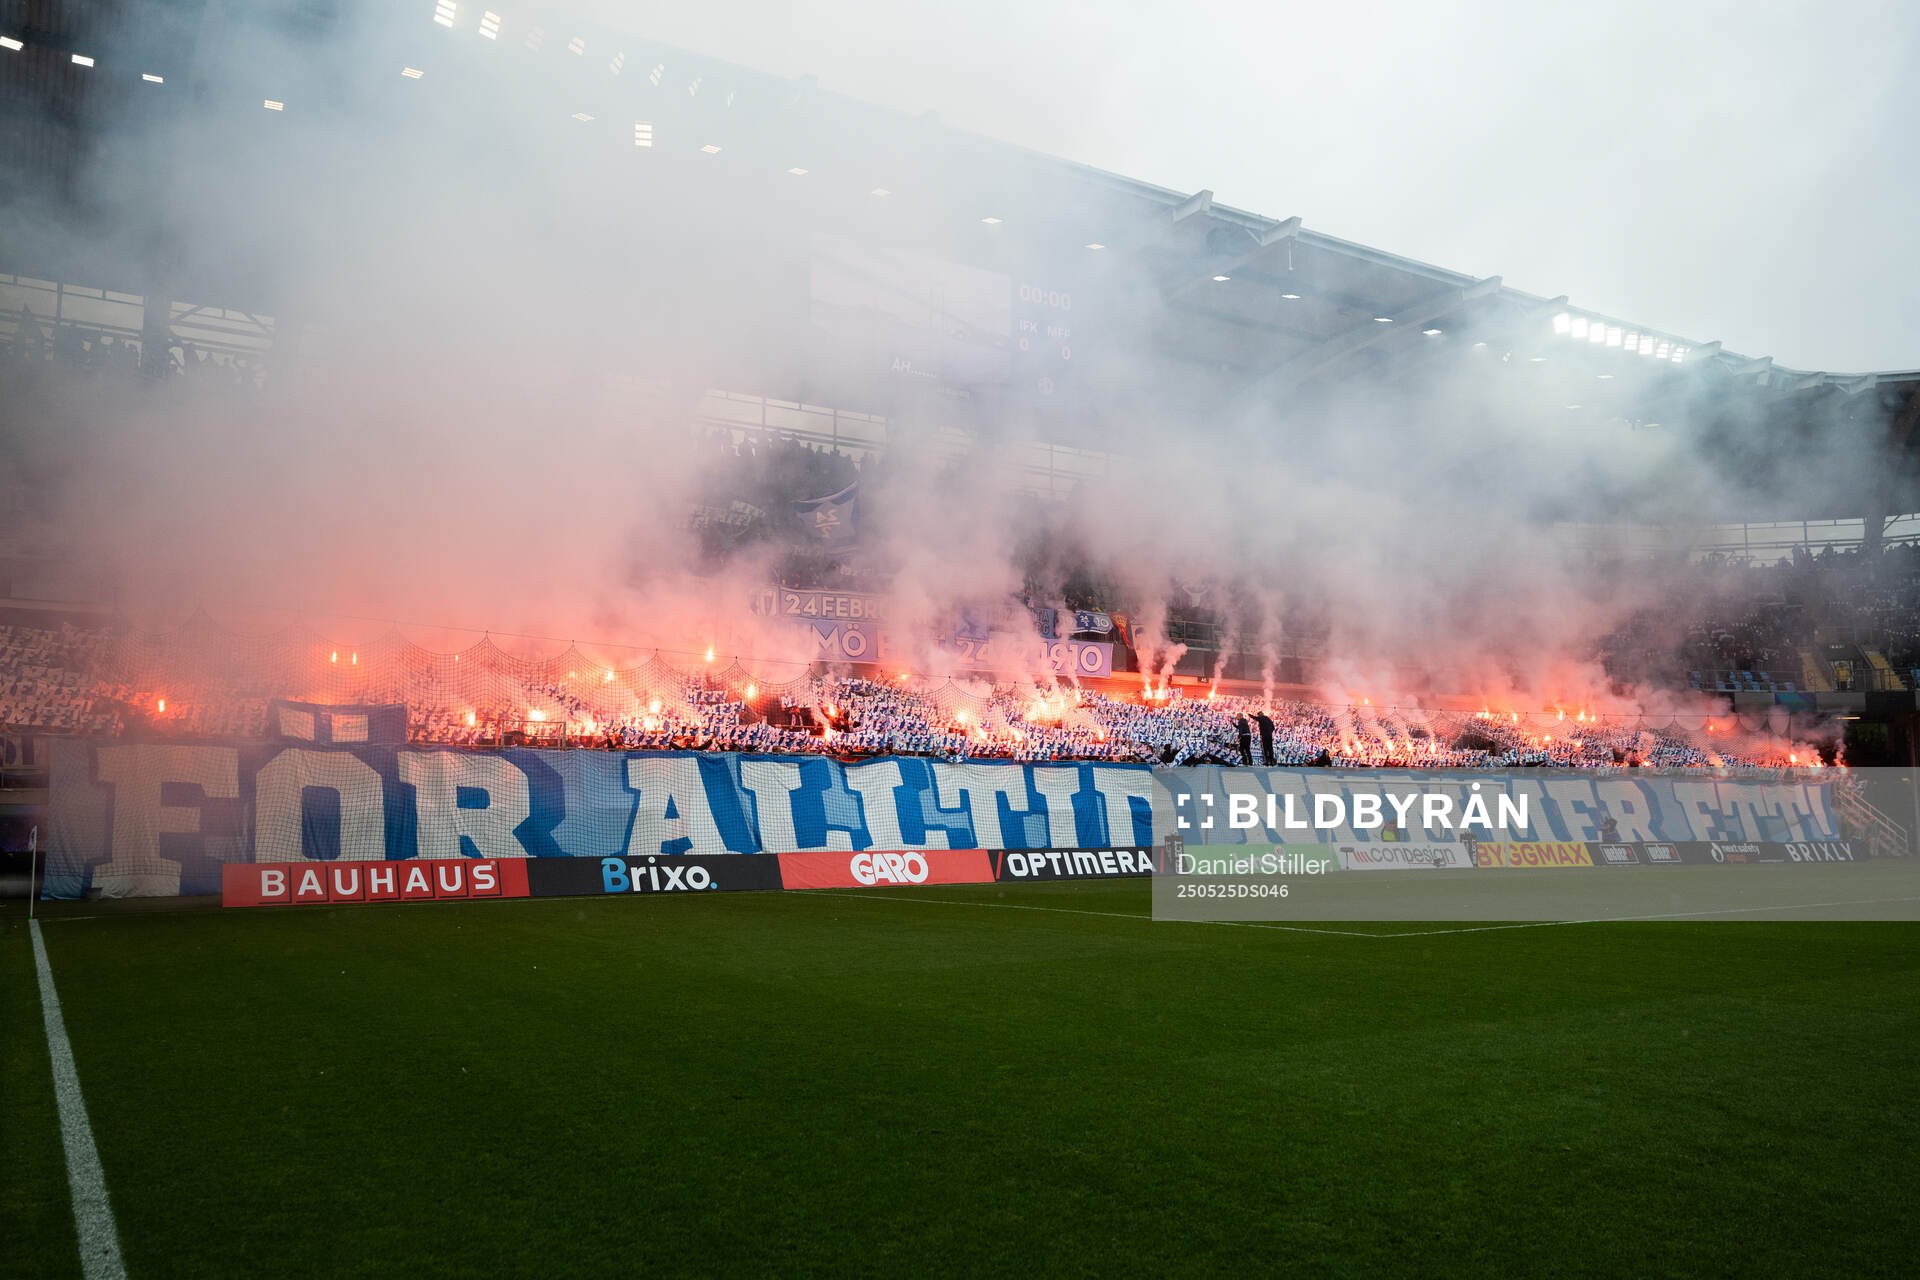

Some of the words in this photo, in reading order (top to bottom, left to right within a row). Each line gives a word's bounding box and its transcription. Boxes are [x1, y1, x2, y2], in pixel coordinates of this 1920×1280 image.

[1020, 286, 1072, 311] 00:00
[92, 706, 537, 898] FÖR
[626, 755, 1181, 856] ALLTID
[1007, 846, 1157, 878] OPTIMERA
[1477, 842, 1589, 867] BYGGMAX
[1785, 842, 1853, 862] BRIXLY
[260, 863, 496, 898] BAUHAUS
[602, 857, 718, 893] Brixo.
